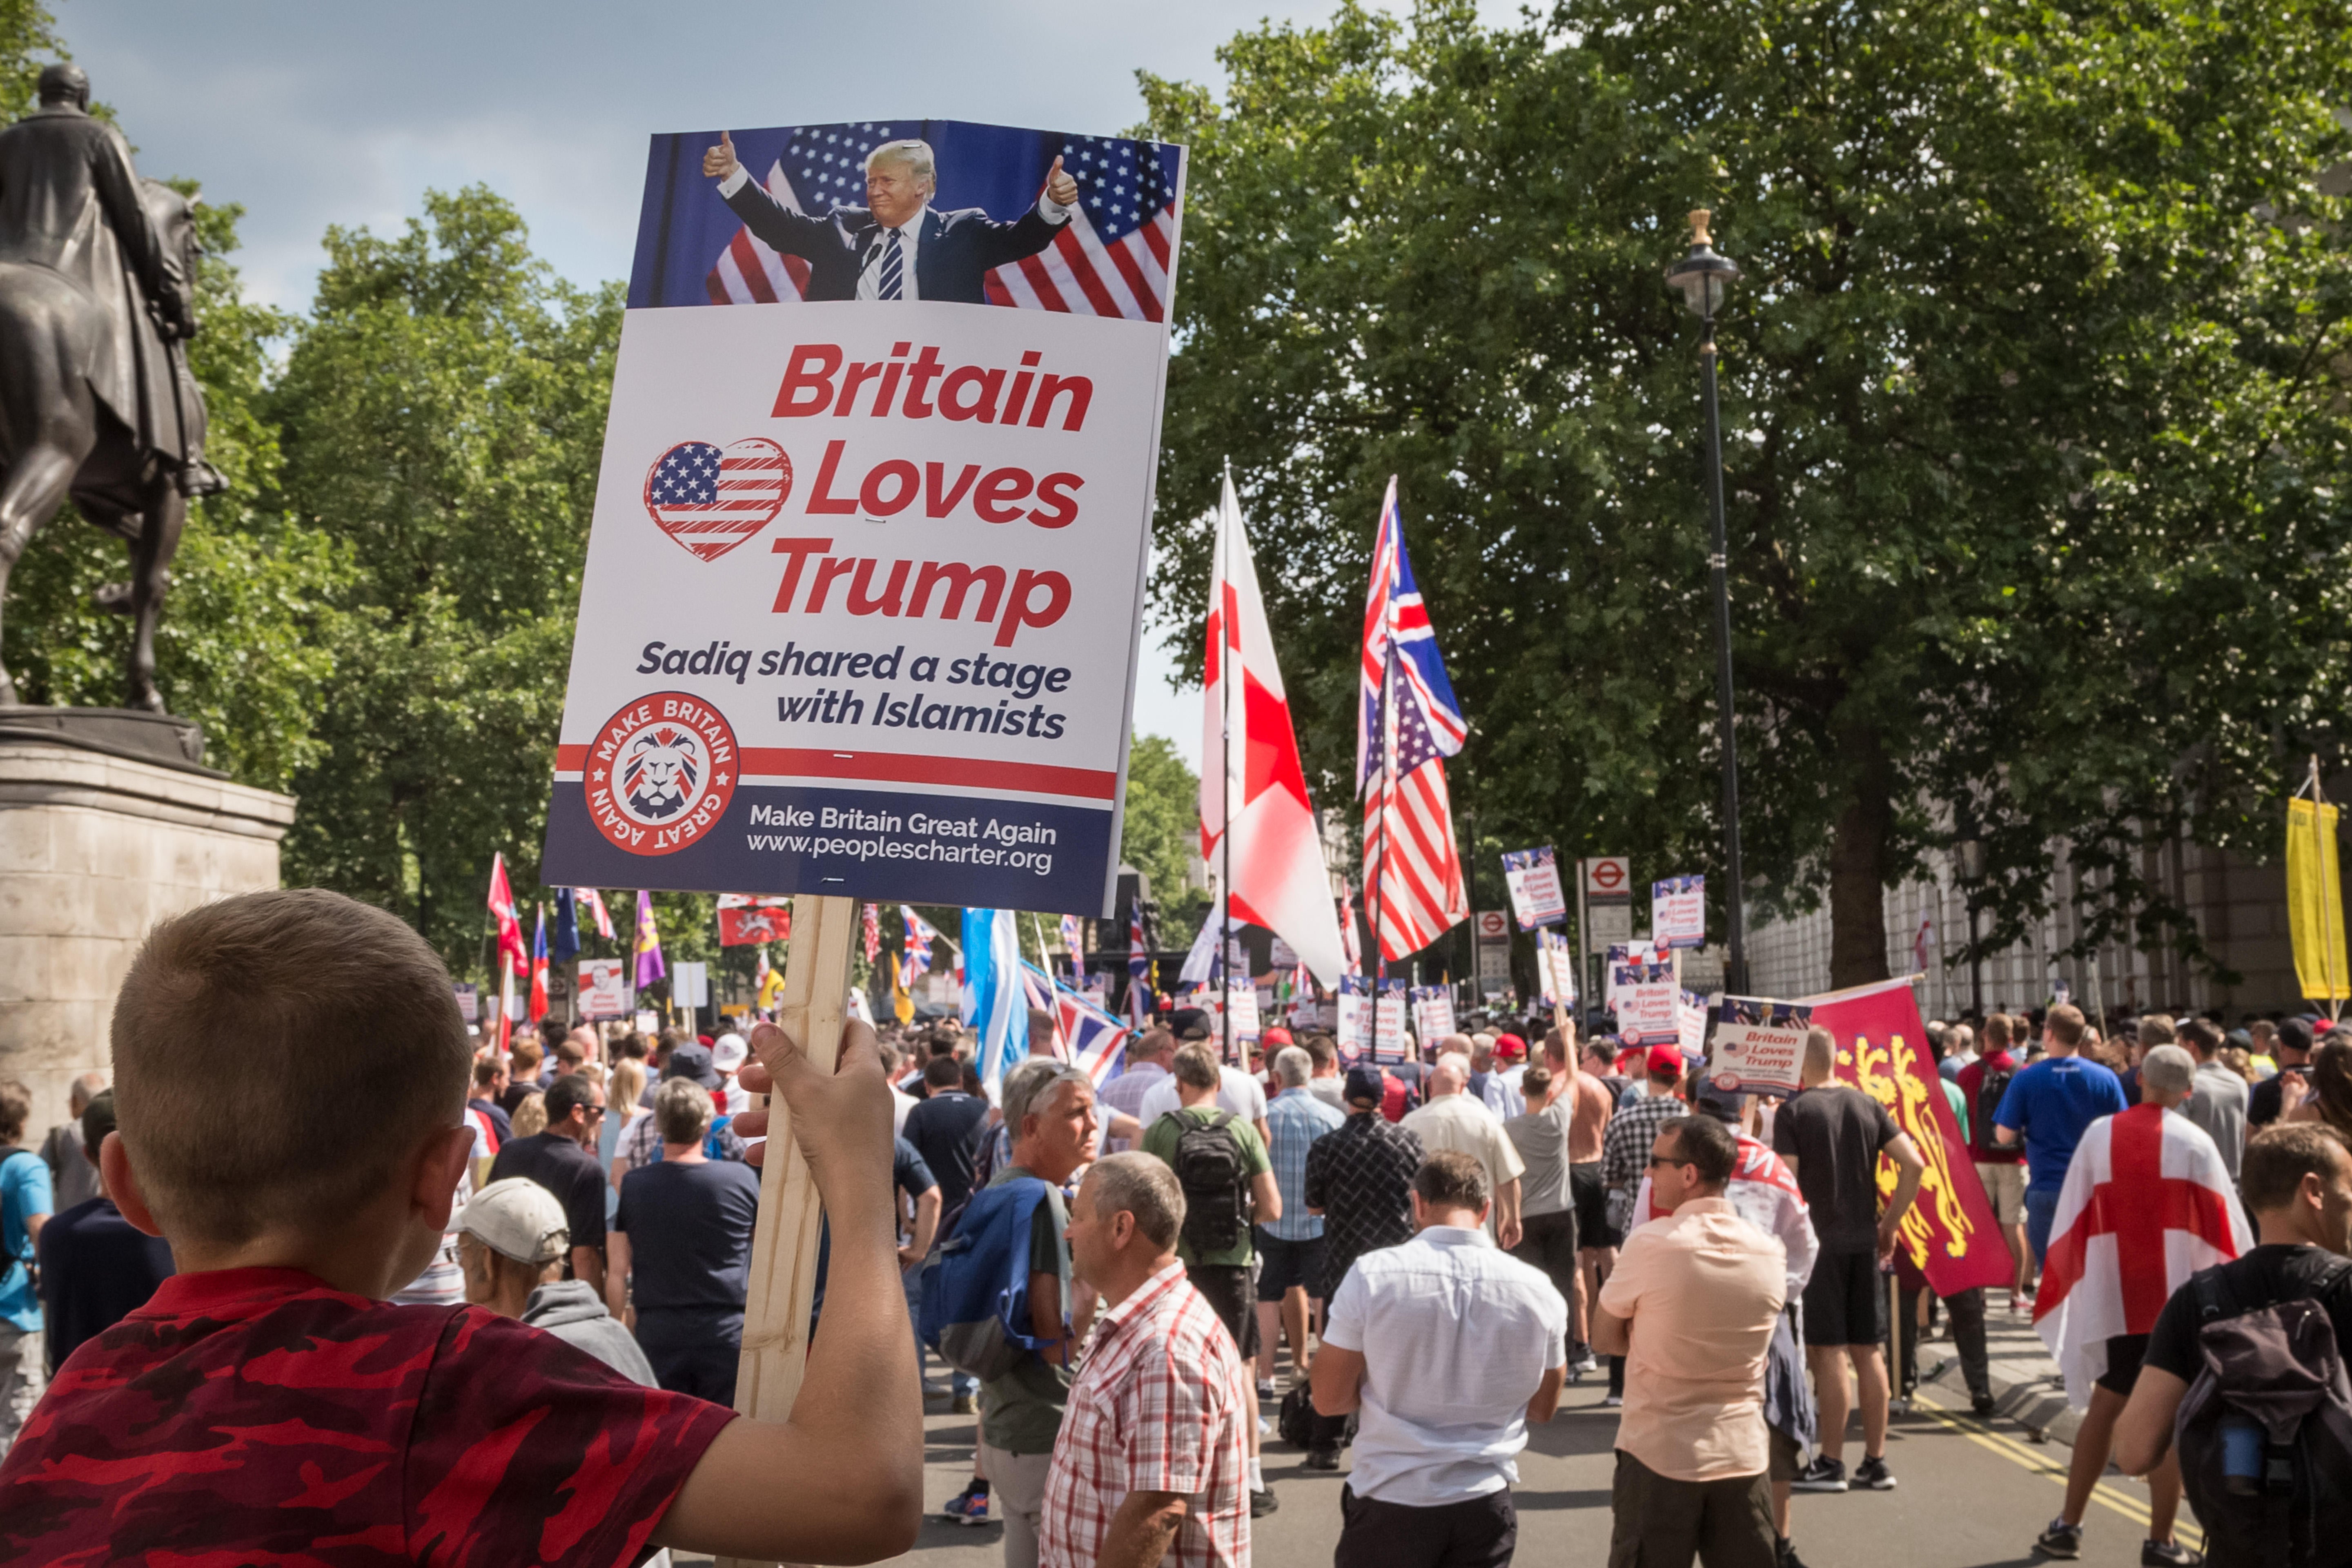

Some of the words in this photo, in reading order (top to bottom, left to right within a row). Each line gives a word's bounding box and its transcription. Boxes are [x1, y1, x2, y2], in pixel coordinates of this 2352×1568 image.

[772, 342, 1092, 431] Britain
[805, 440, 1084, 528] Loves
[772, 538, 1071, 647] Trump
[636, 641, 752, 684] Sadiq
[757, 641, 904, 680] shared
[910, 656, 940, 682] a
[946, 653, 1071, 699] stage
[597, 704, 653, 762] MAKE
[663, 700, 731, 764] BRITAIN
[778, 689, 864, 724] with
[872, 692, 1067, 739] Islamists
[592, 788, 646, 846] AGAIN
[654, 794, 721, 849] GREAT
[750, 804, 815, 827] Make
[820, 807, 902, 833] Britain
[908, 813, 978, 838] Great
[982, 819, 1056, 846] Again
[747, 835, 1052, 875] www.peoplescharter.org
[1745, 1056, 1793, 1069] Trump
[1746, 1031, 1798, 1045] Britain
[1752, 1045, 1795, 1056] Loves
